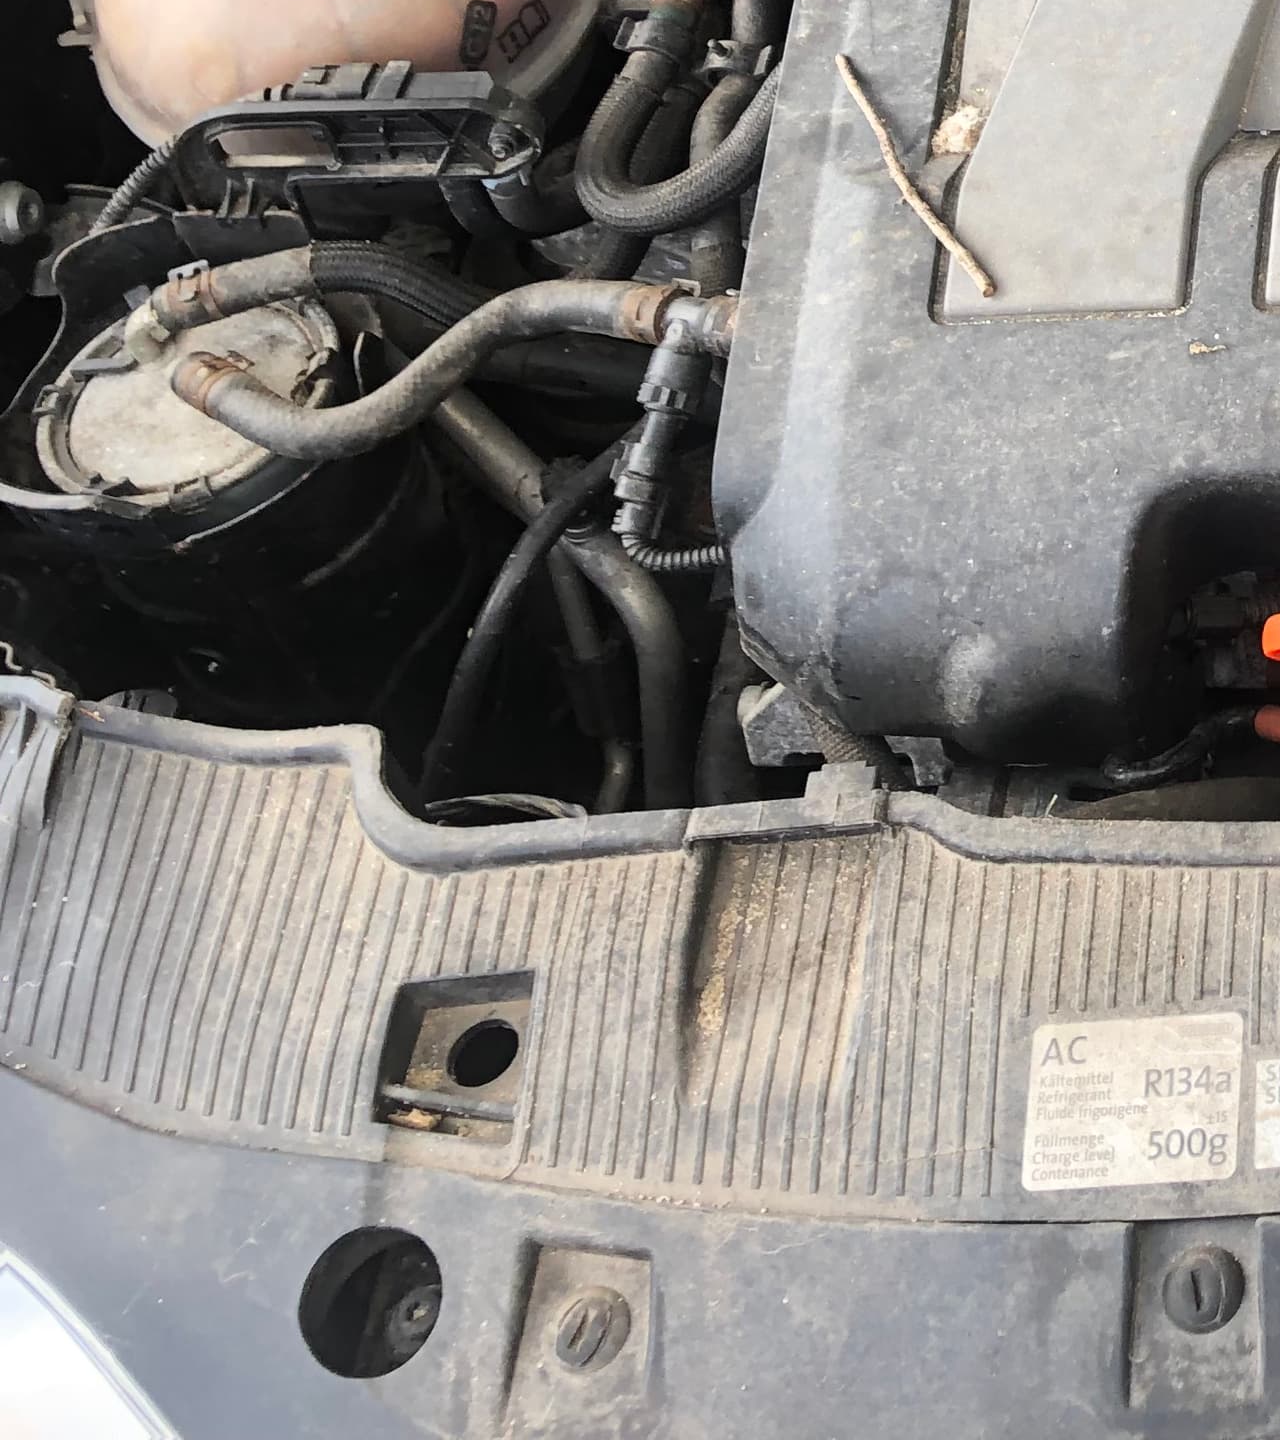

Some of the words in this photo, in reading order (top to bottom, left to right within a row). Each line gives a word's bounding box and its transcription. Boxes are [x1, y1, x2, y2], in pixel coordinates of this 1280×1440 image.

[1041, 1036, 1088, 1066] AC
[1040, 1072, 1114, 1089] Kältemittel
[1144, 1065, 1232, 1098] R134a
[1037, 1089, 1112, 1106] Refrigerant
[1034, 1132, 1105, 1150] Füllmenge
[1148, 1128, 1228, 1166] 500g
[1032, 1151, 1080, 1167] Charge
[1031, 1167, 1109, 1182] Contenance
